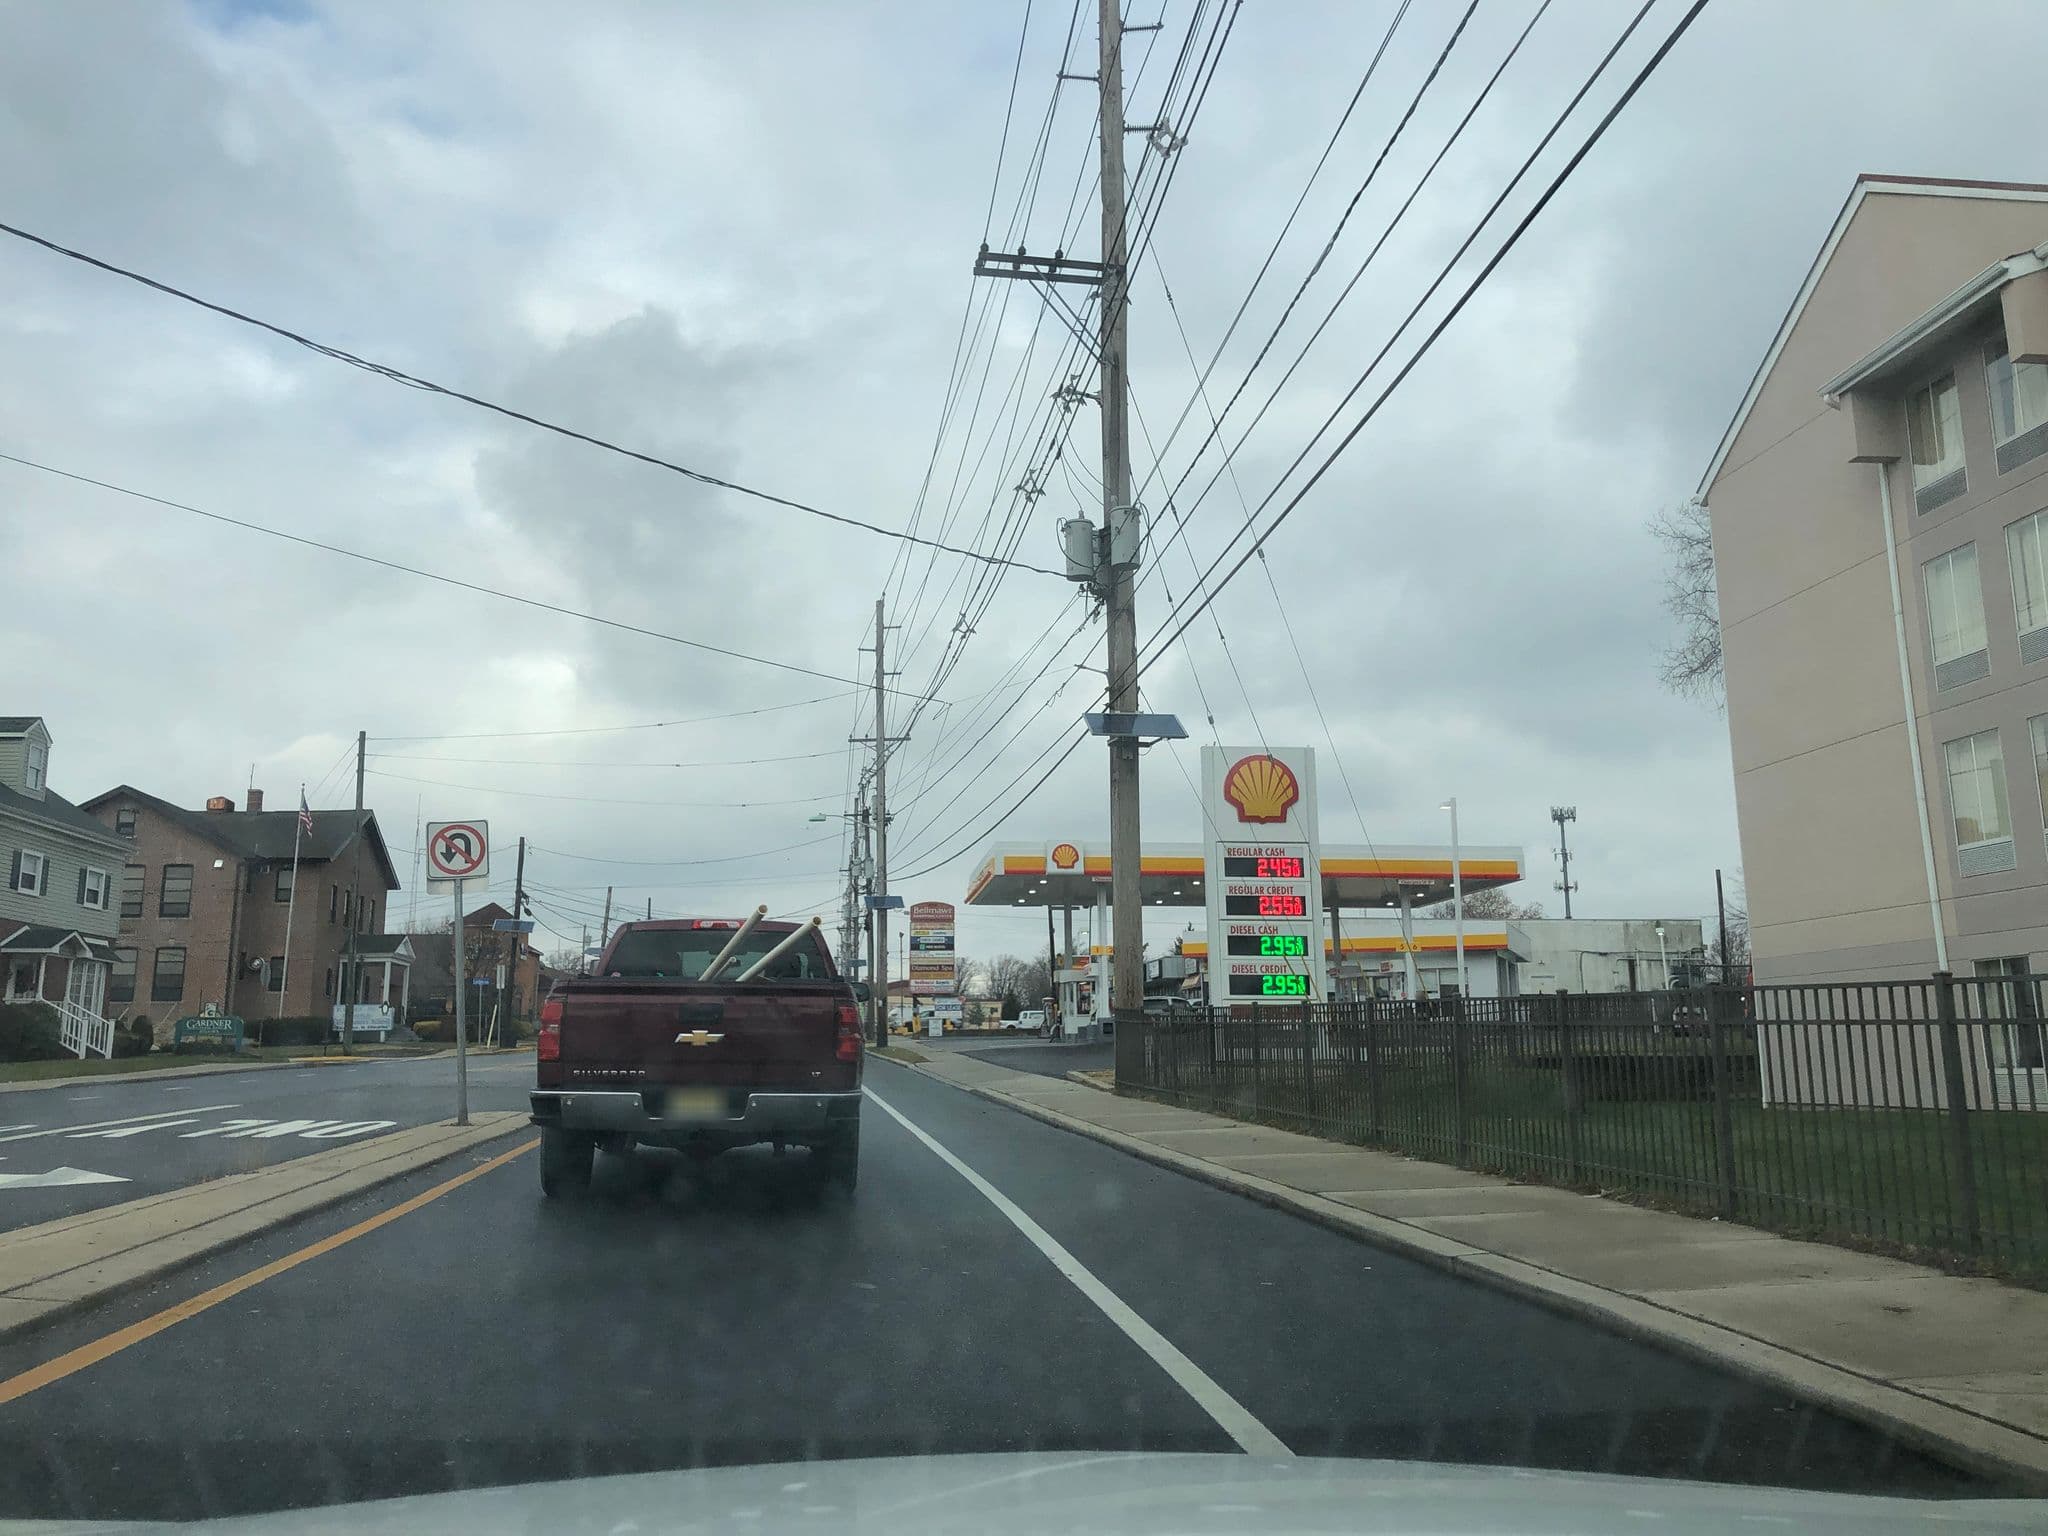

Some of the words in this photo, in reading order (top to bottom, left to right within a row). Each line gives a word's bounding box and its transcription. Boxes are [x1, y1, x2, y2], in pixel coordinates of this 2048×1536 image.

[1227, 847, 1263, 857] REGULAR
[1265, 847, 1286, 857] CASH
[1228, 886, 1265, 895] REGULAR
[1267, 886, 1294, 895] CREDIT
[1230, 925, 1256, 934] DIESEL
[1258, 925, 1279, 934] CASH
[1231, 964, 1257, 973] DIESEL
[1260, 964, 1288, 973] CREDIT
[186, 1019, 232, 1030] GARDNER
